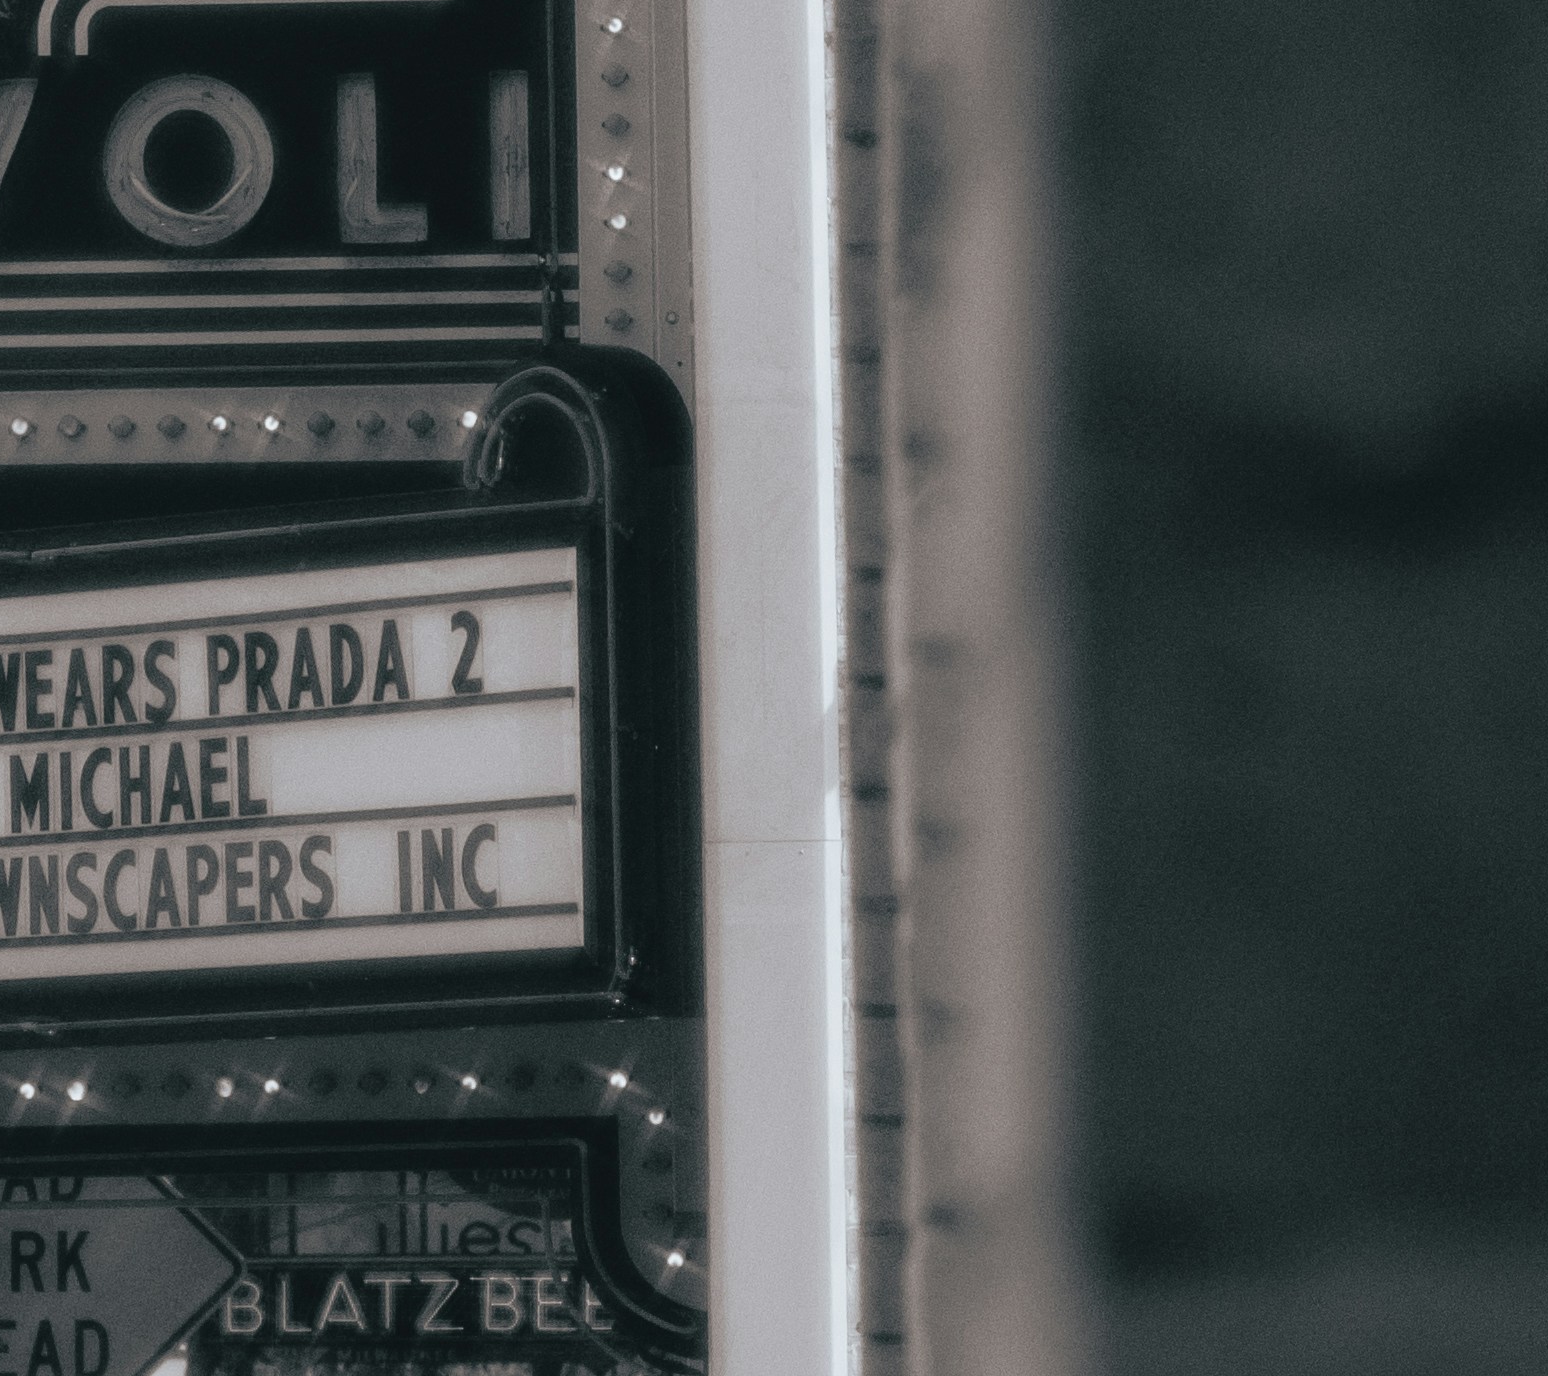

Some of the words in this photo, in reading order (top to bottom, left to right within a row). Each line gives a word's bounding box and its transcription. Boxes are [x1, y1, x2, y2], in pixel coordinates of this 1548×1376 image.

[206, 618, 409, 719] PRADA
[448, 610, 484, 696] 2
[8, 735, 268, 835] MICHAEL
[396, 824, 498, 915] INC
[223, 1274, 465, 1335] BLATZ
